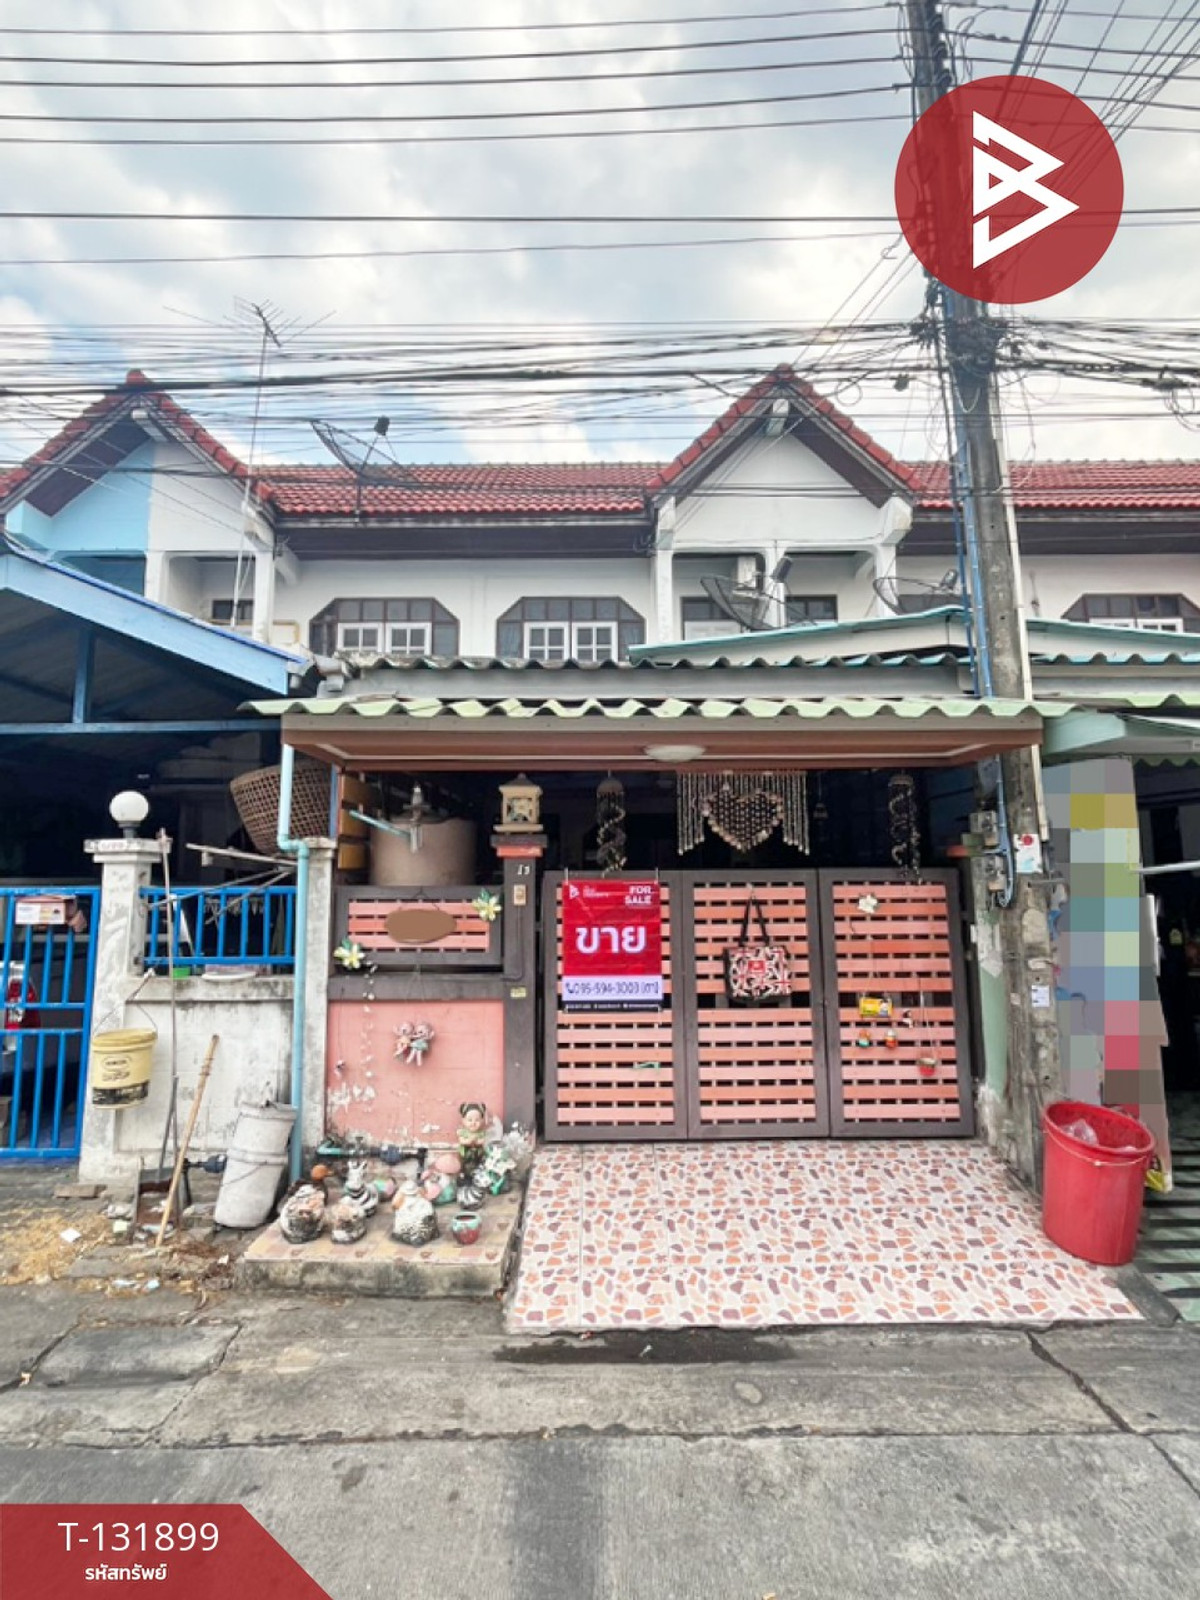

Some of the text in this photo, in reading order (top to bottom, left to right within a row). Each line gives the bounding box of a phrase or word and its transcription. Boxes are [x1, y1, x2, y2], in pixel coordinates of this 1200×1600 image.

[628, 885, 651, 894] FOR
[625, 895, 651, 904] SALE
[576, 927, 645, 953] ขาย
